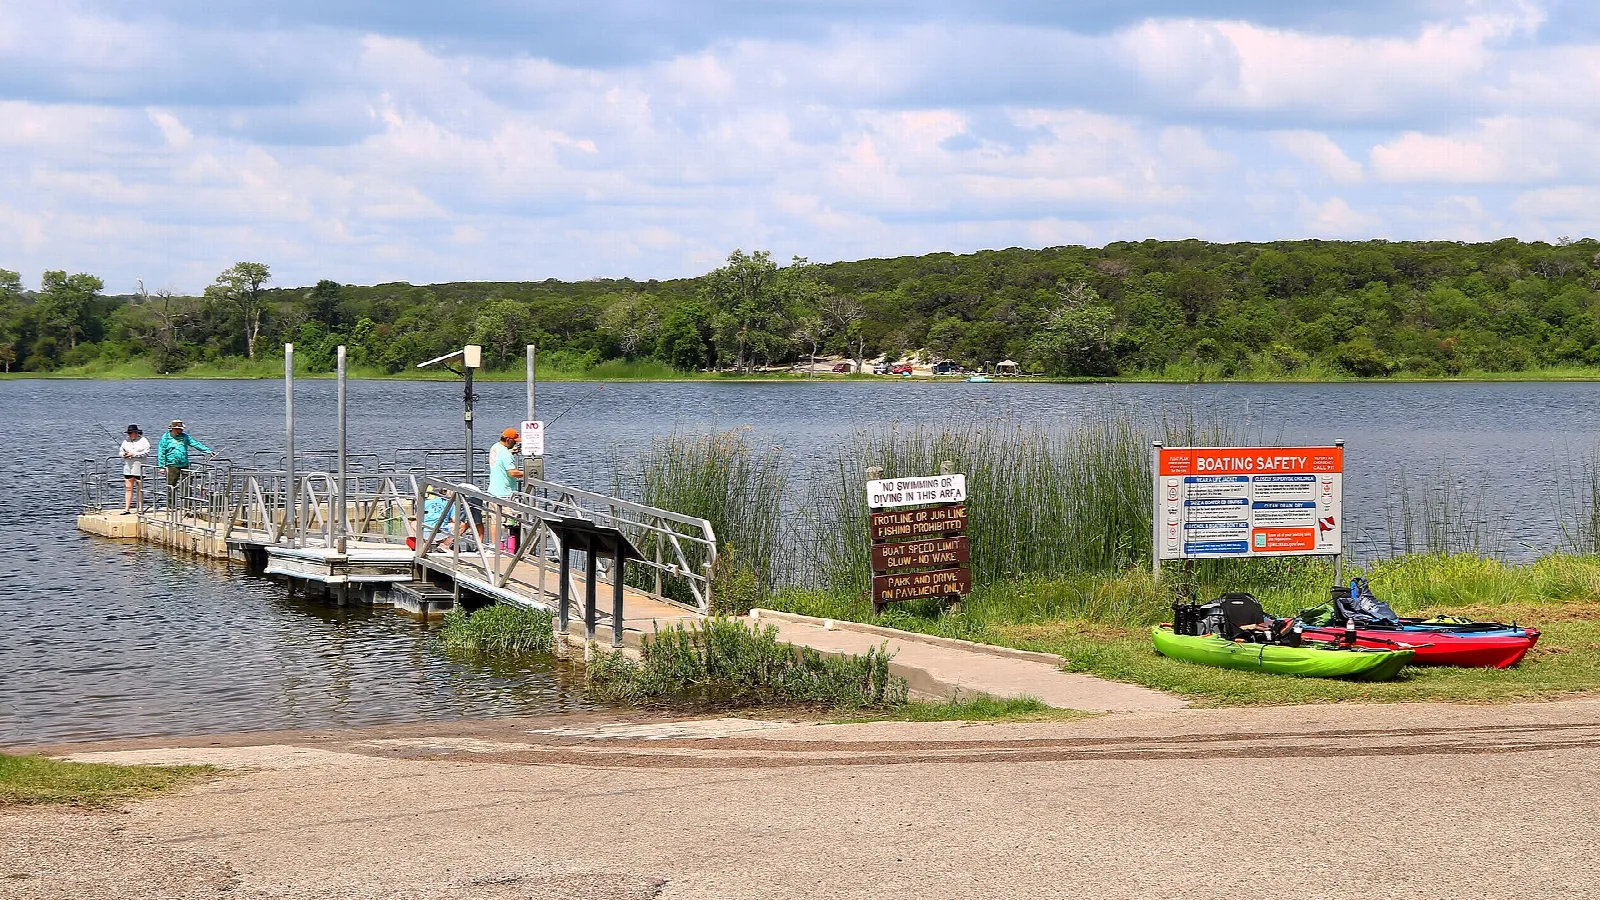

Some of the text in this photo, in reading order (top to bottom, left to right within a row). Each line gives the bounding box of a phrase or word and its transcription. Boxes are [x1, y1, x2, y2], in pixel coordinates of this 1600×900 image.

[525, 422, 539, 430] NO
[1197, 456, 1307, 471] BOATING SAFETY
[882, 478, 952, 492] NO SWIMMING OR
[874, 488, 962, 504] DIVING IN THIS AREA
[874, 507, 967, 526] TROTLINE OR JUG LINE
[878, 519, 962, 537] FISHING PROHIBITED
[882, 540, 960, 557] BOAT SPEED LIMIT
[887, 556, 912, 568] SLOW
[918, 554, 929, 564] NO
[932, 552, 957, 563] WAKE
[888, 573, 958, 588] PARK AND DRIVE
[881, 582, 965, 599] ON PAVEMENT ONLY
